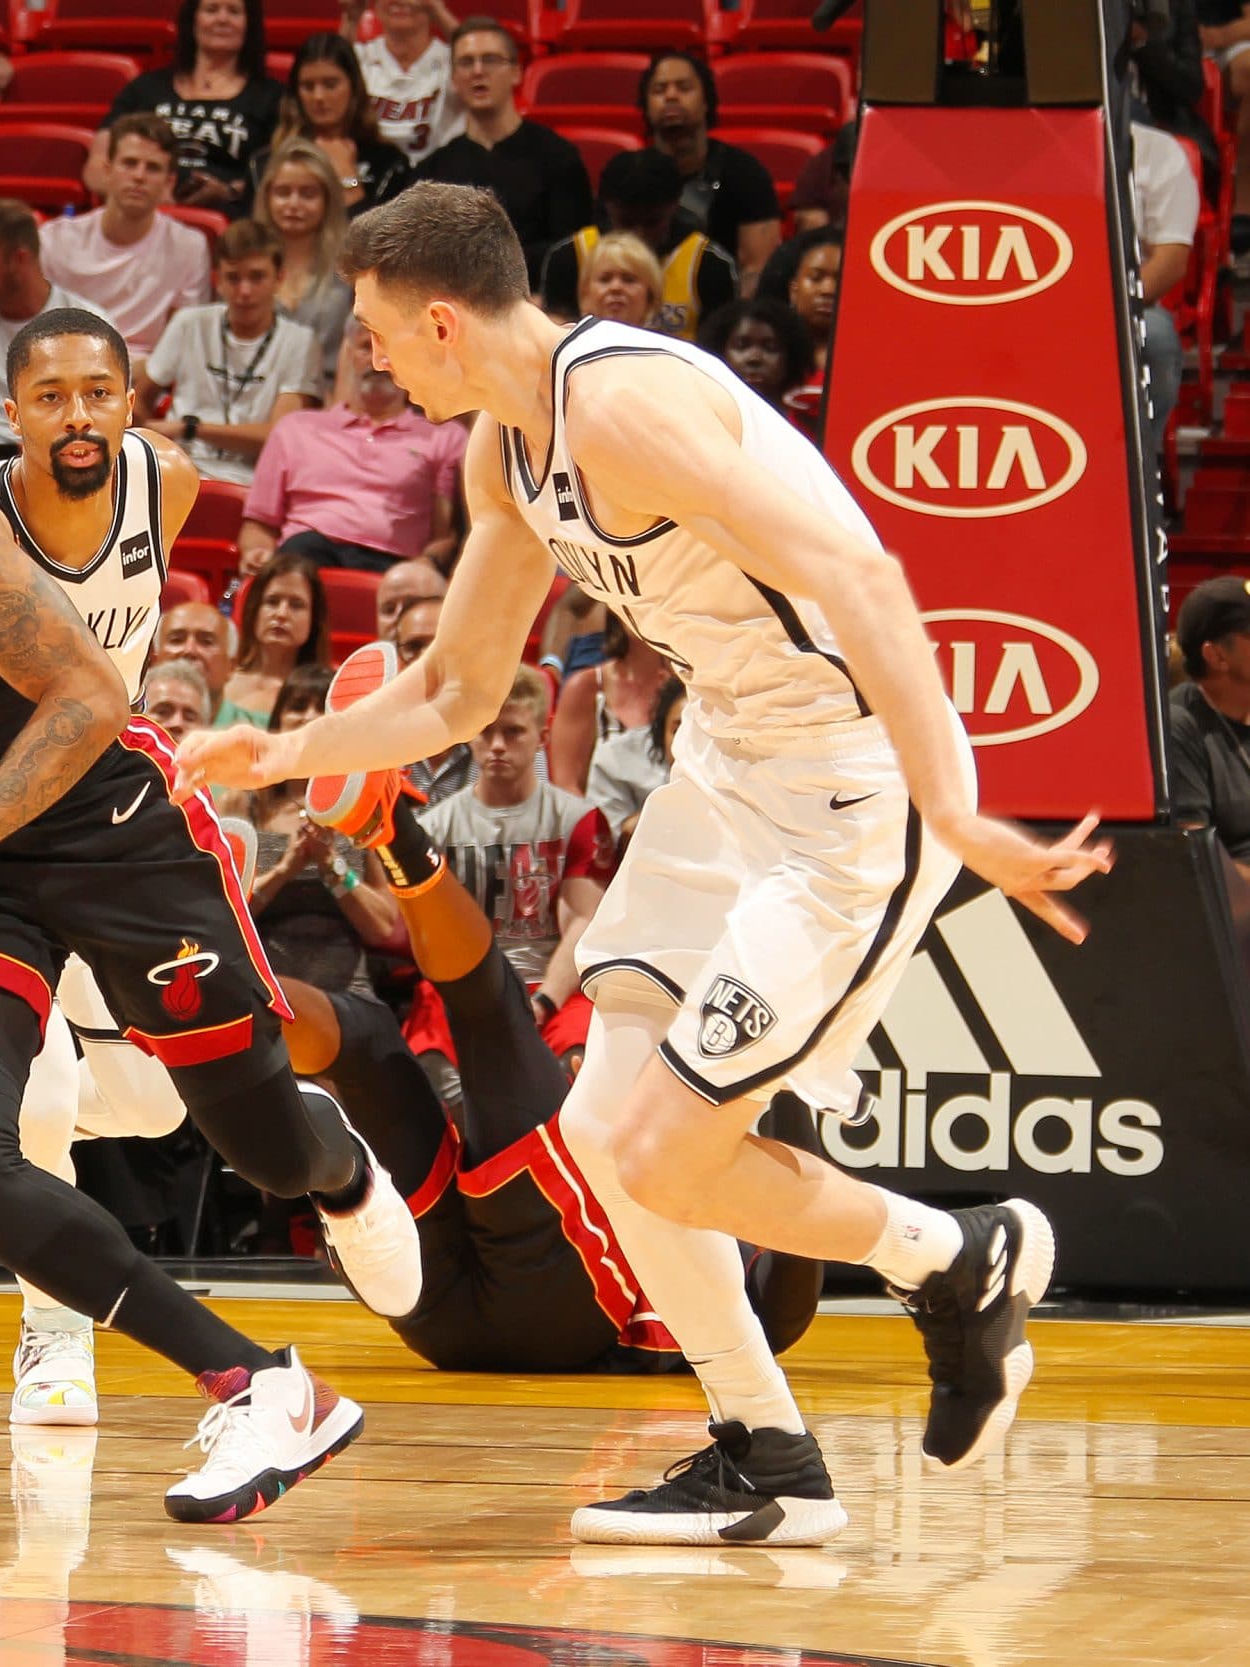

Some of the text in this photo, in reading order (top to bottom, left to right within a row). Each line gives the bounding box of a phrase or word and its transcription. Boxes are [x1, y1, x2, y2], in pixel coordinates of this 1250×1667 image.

[164, 116, 249, 160] EAT
[905, 225, 1039, 281] KIA
[893, 425, 1047, 490] KIA
[122, 545, 150, 566] infor
[930, 641, 1054, 715] IA
[706, 979, 771, 1040] NETS
[812, 1070, 1164, 1176] didas
